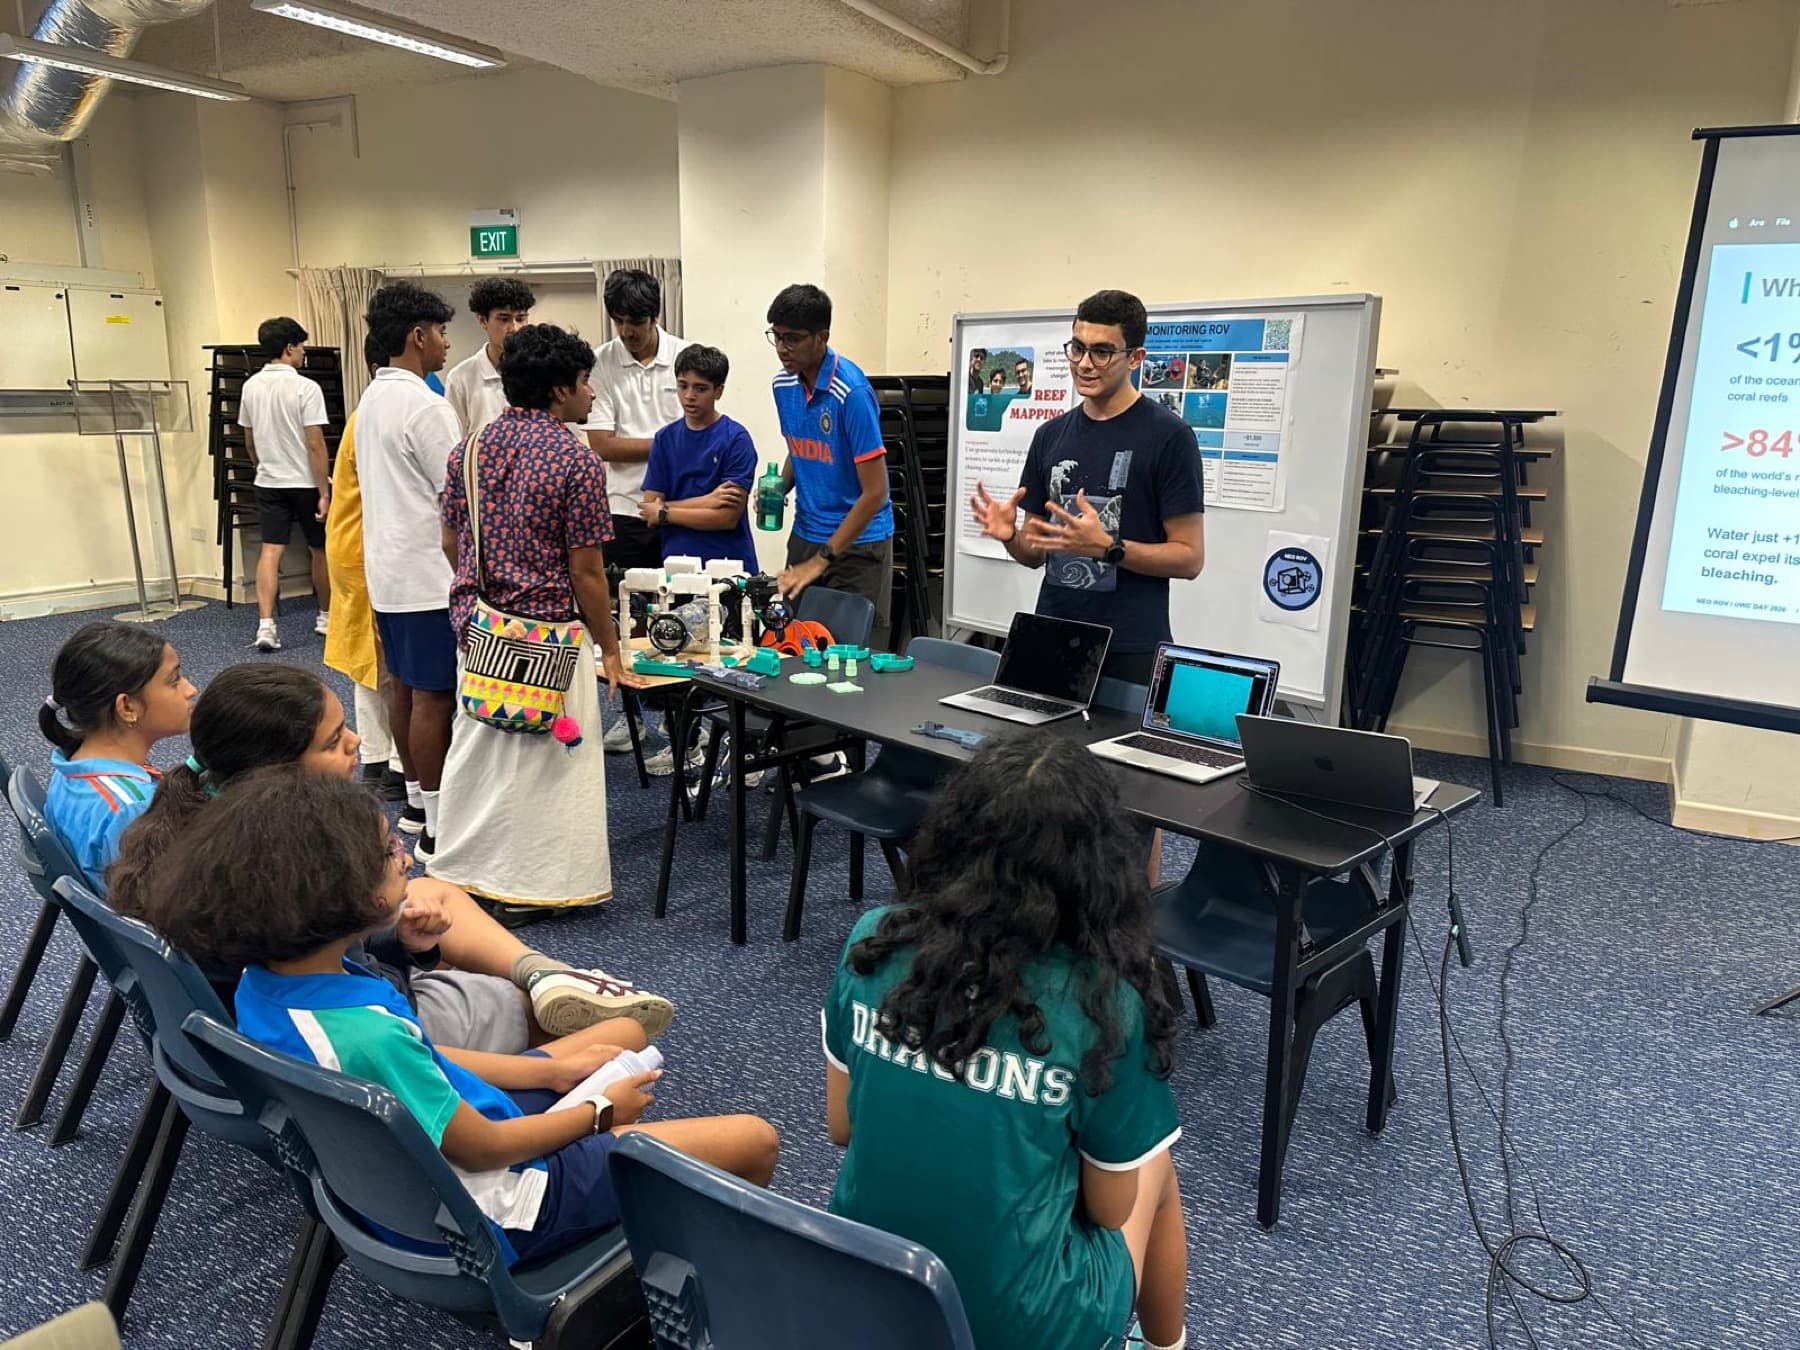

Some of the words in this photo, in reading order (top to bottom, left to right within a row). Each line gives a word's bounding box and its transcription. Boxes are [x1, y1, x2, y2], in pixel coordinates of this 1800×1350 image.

[480, 231, 507, 252] EXIT
[1209, 323, 1231, 335] ROV
[1729, 374, 1743, 385] of
[1744, 375, 1763, 385] the
[1034, 389, 1067, 401] REEF
[1727, 391, 1756, 401] coral
[1759, 392, 1789, 402] reefs
[1715, 468, 1728, 478] of
[1730, 469, 1748, 479] the
[1751, 472, 1792, 481] world's
[1713, 484, 1800, 498] bleaching-level
[1707, 527, 1749, 541] Water
[1752, 530, 1779, 544] just
[1704, 549, 1738, 560] coral
[1742, 552, 1780, 565] expel
[1701, 566, 1778, 585] bleaching.
[1753, 603, 1768, 611] DAY
